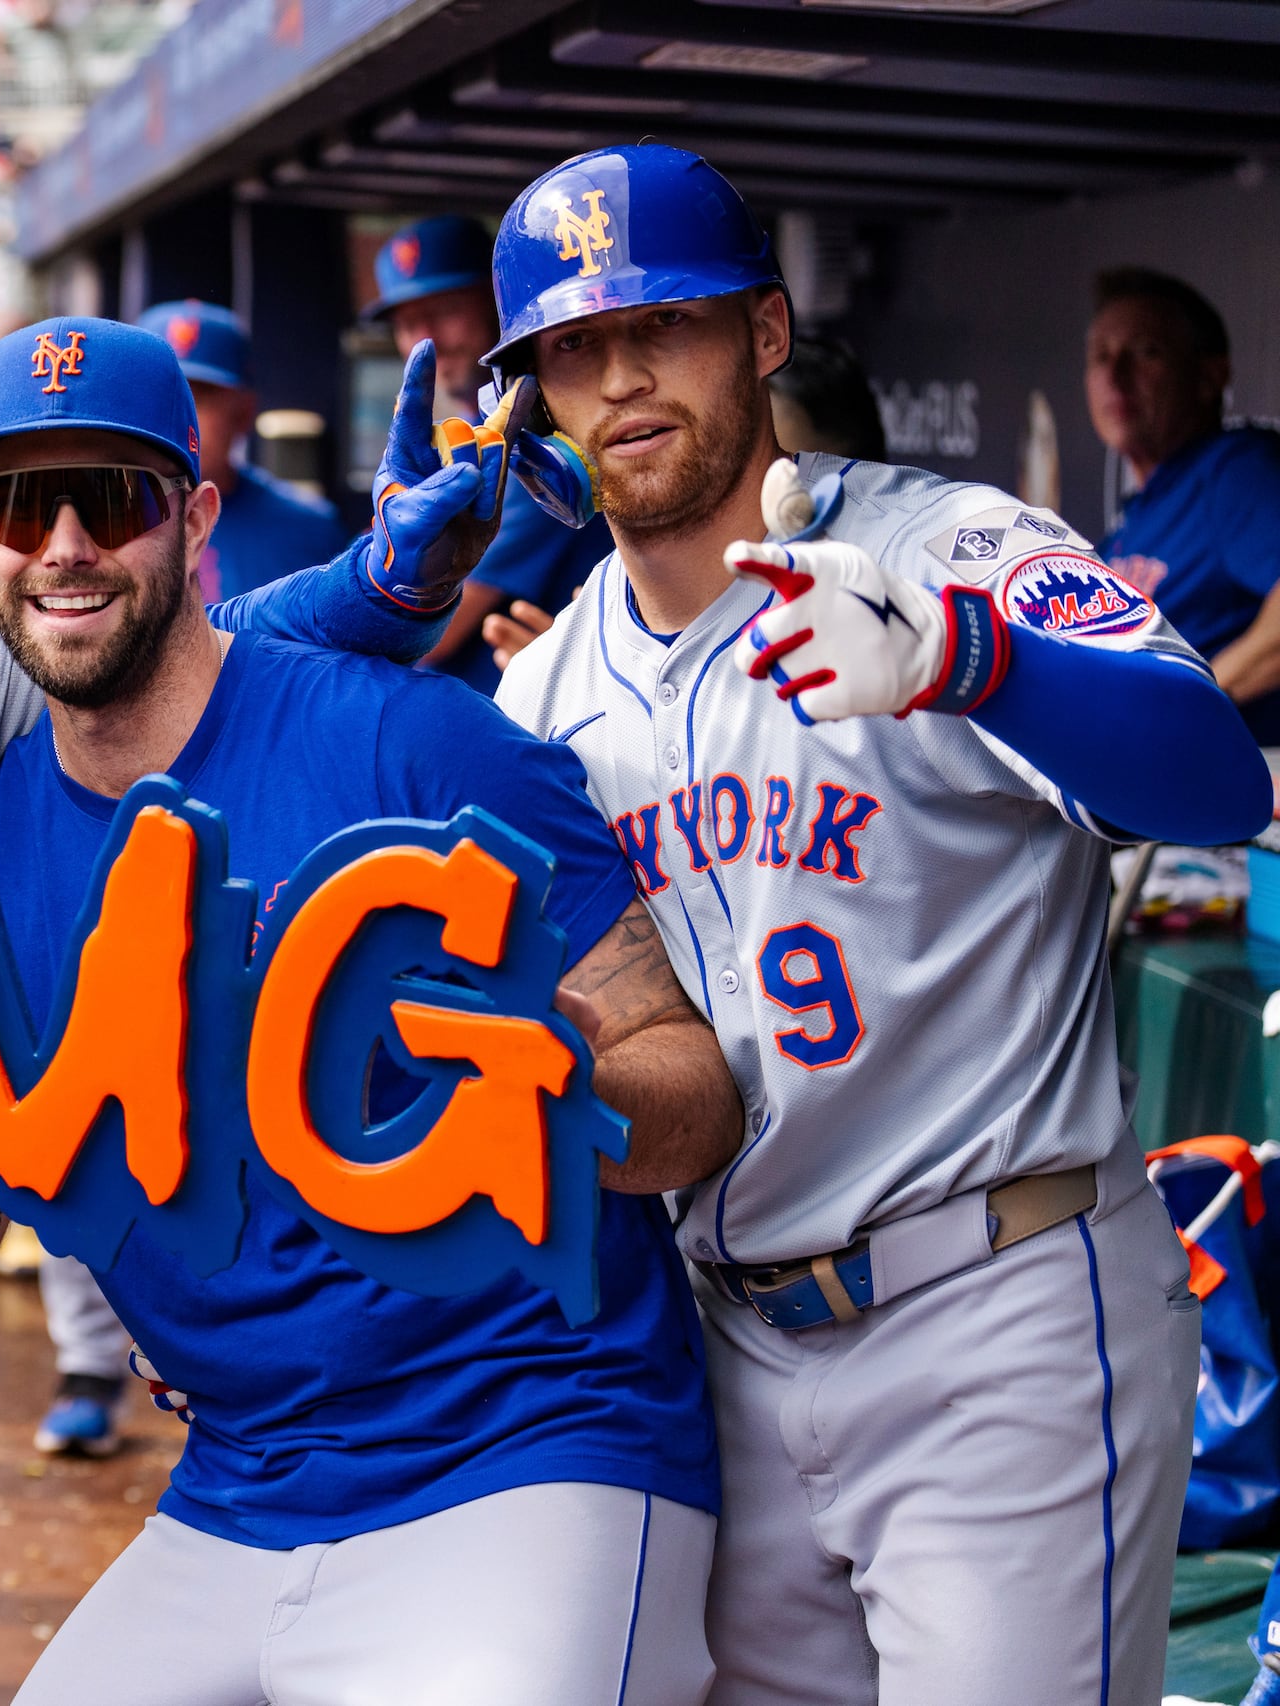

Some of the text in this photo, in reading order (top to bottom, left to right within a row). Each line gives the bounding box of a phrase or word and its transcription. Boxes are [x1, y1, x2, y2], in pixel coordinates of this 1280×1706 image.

[552, 189, 615, 279] NY
[31, 331, 87, 394] NY
[1043, 589, 1128, 631] Mets
[669, 771, 884, 884] YORK
[755, 920, 866, 1073] 9
